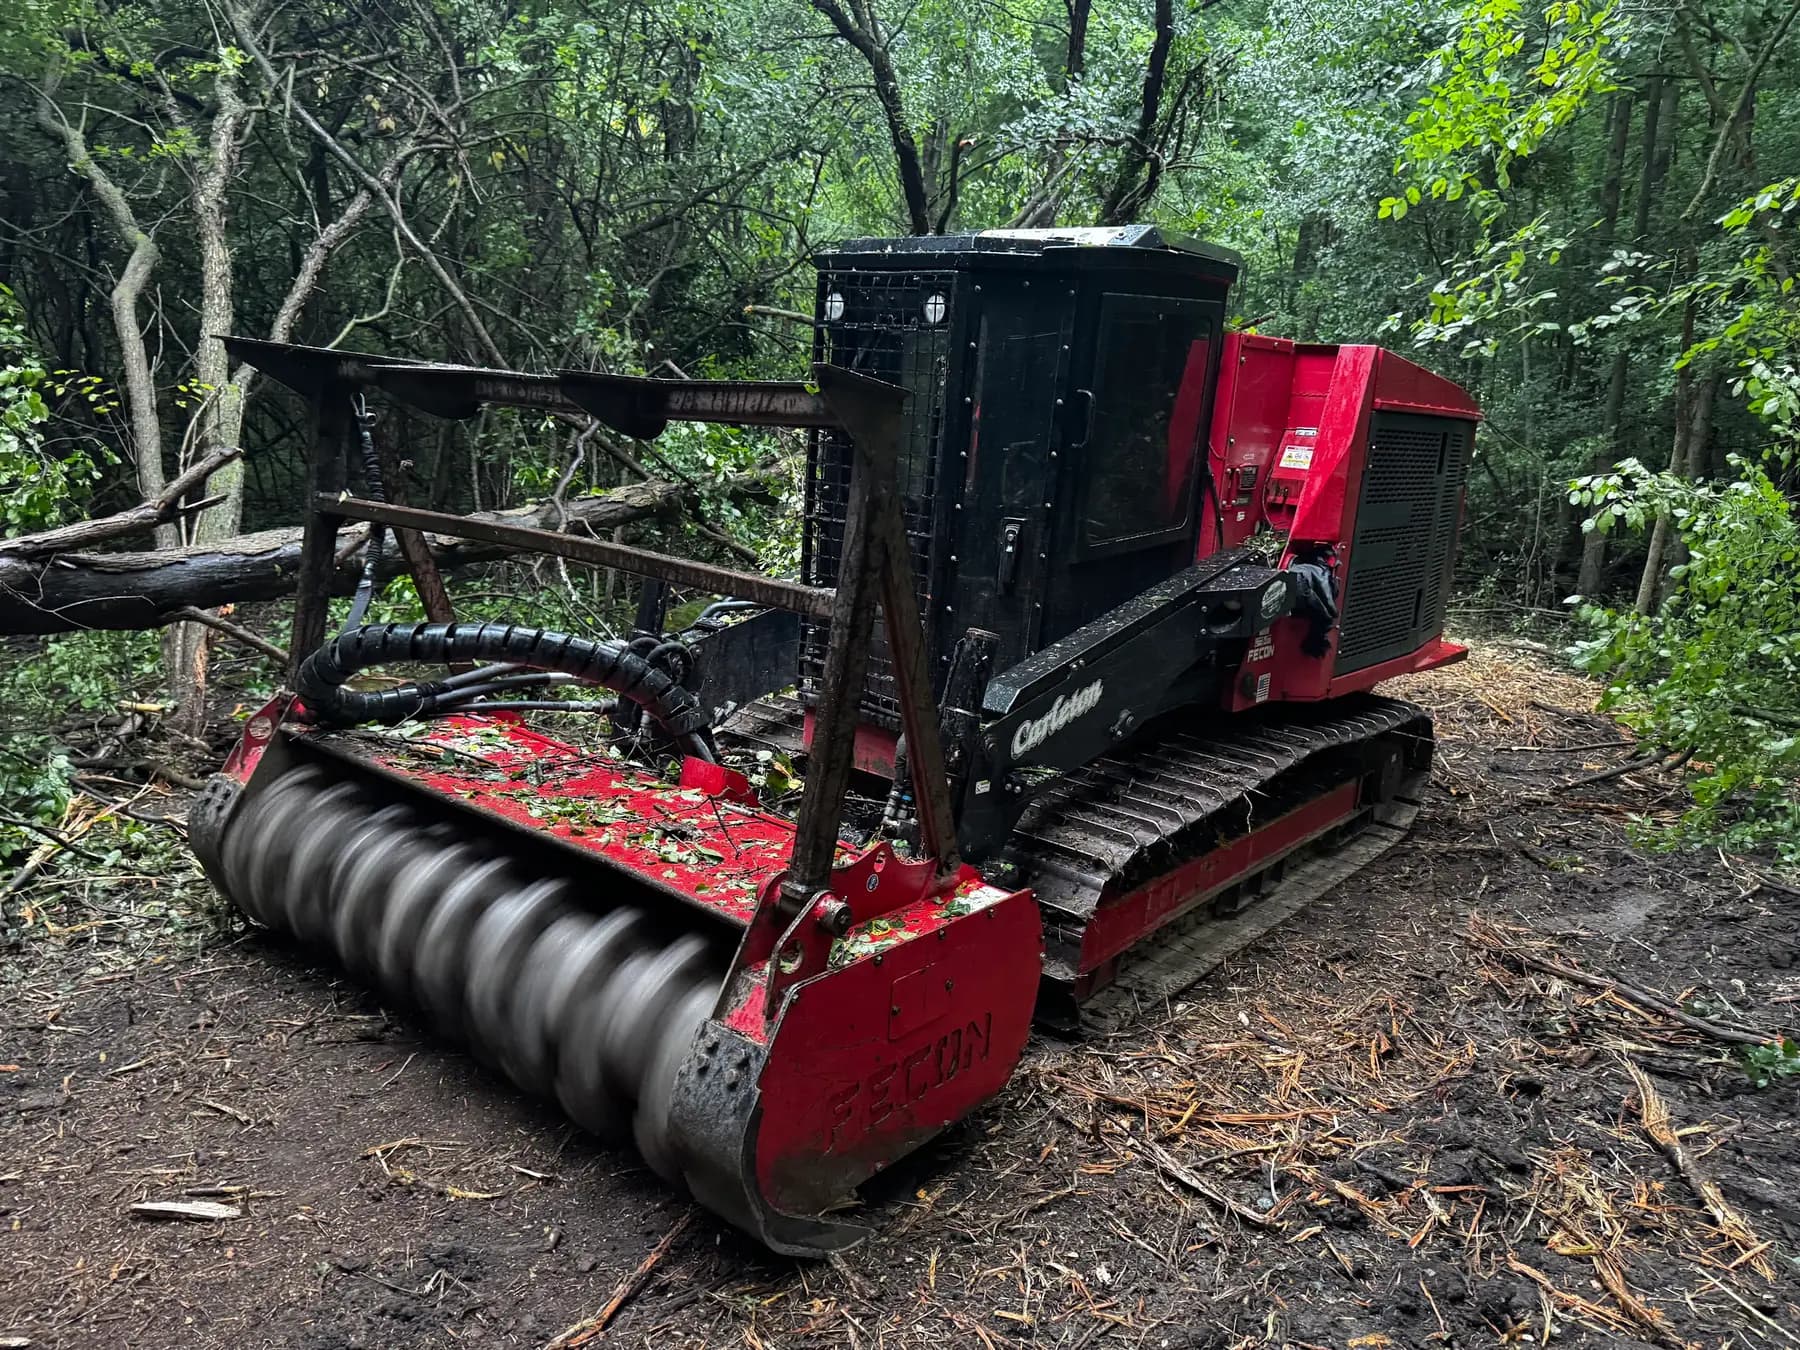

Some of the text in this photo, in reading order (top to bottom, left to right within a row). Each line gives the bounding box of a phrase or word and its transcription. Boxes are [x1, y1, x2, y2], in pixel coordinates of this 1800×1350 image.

[1247, 644, 1275, 663] FECON
[1011, 679, 1103, 760] Carlton
[823, 1012, 992, 1156] FECON
